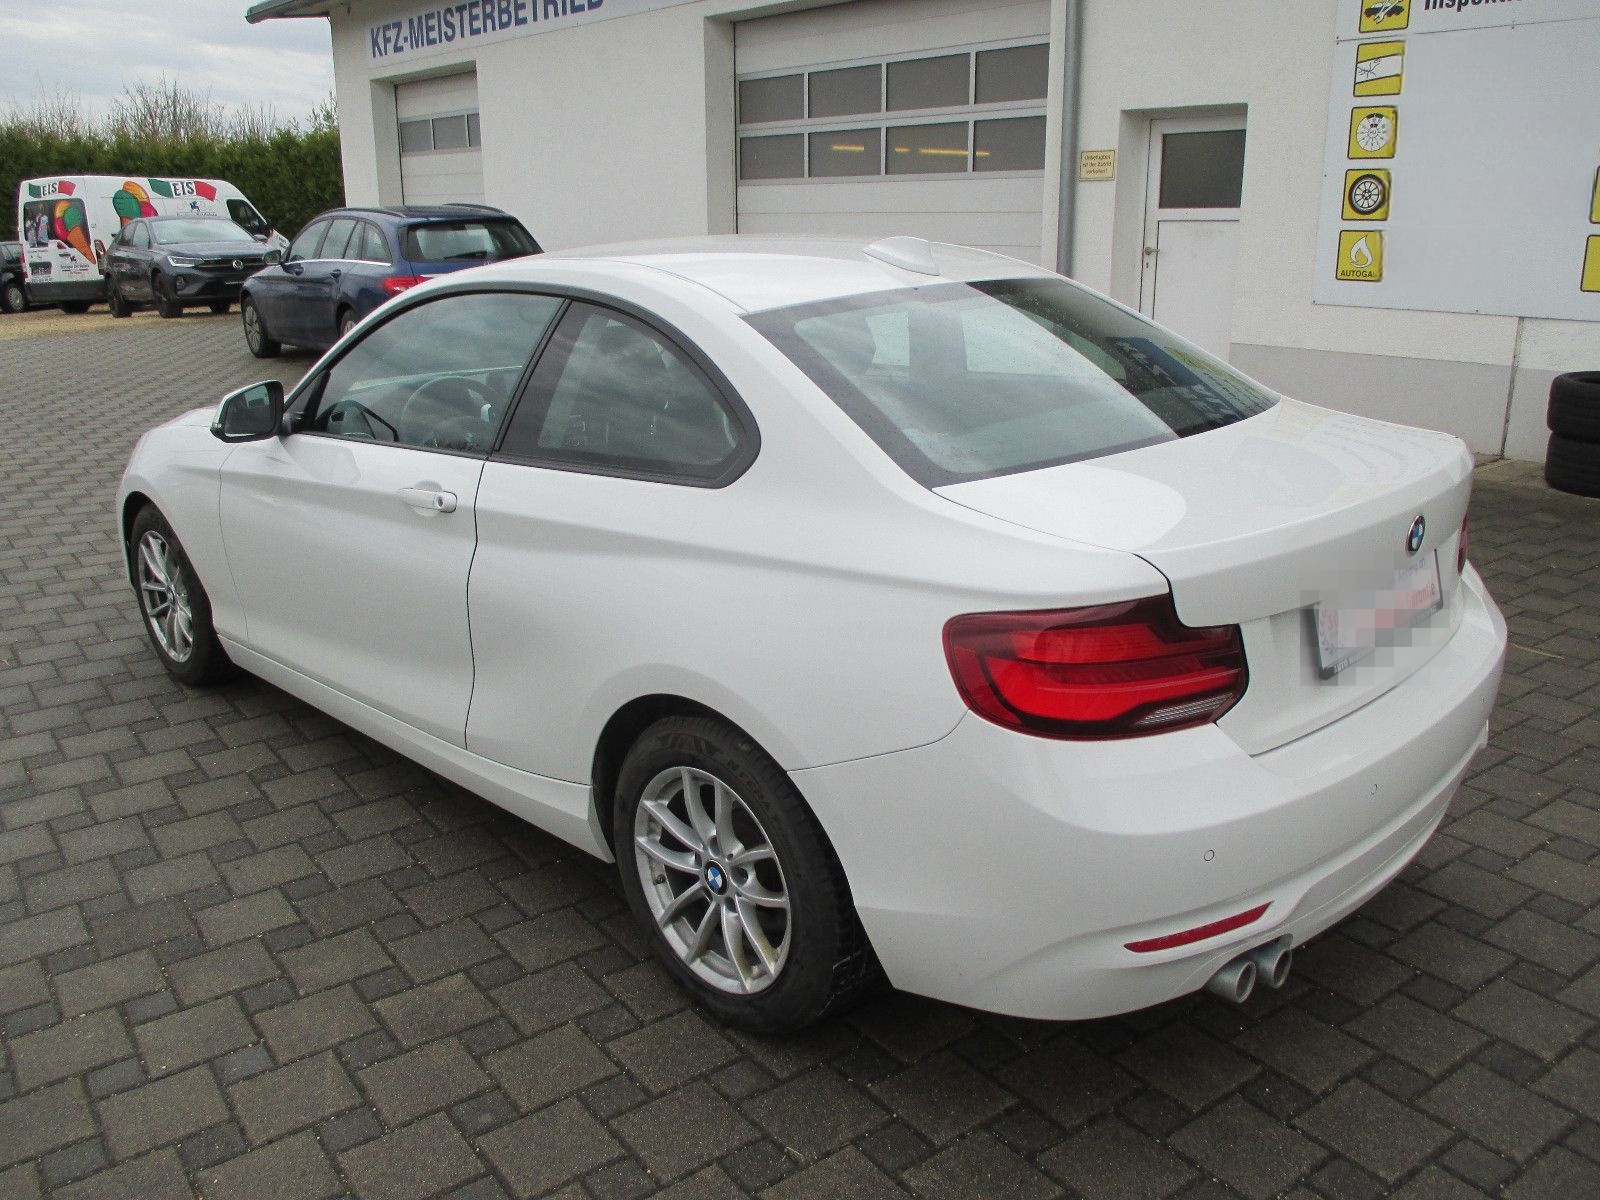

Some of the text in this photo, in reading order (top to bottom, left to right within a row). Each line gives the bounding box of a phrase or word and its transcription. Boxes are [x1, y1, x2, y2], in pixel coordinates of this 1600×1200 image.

[370, 0, 603, 58] KFZ-MEISTERBETR
[42, 182, 58, 196] EIS
[172, 181, 195, 197] EIS
